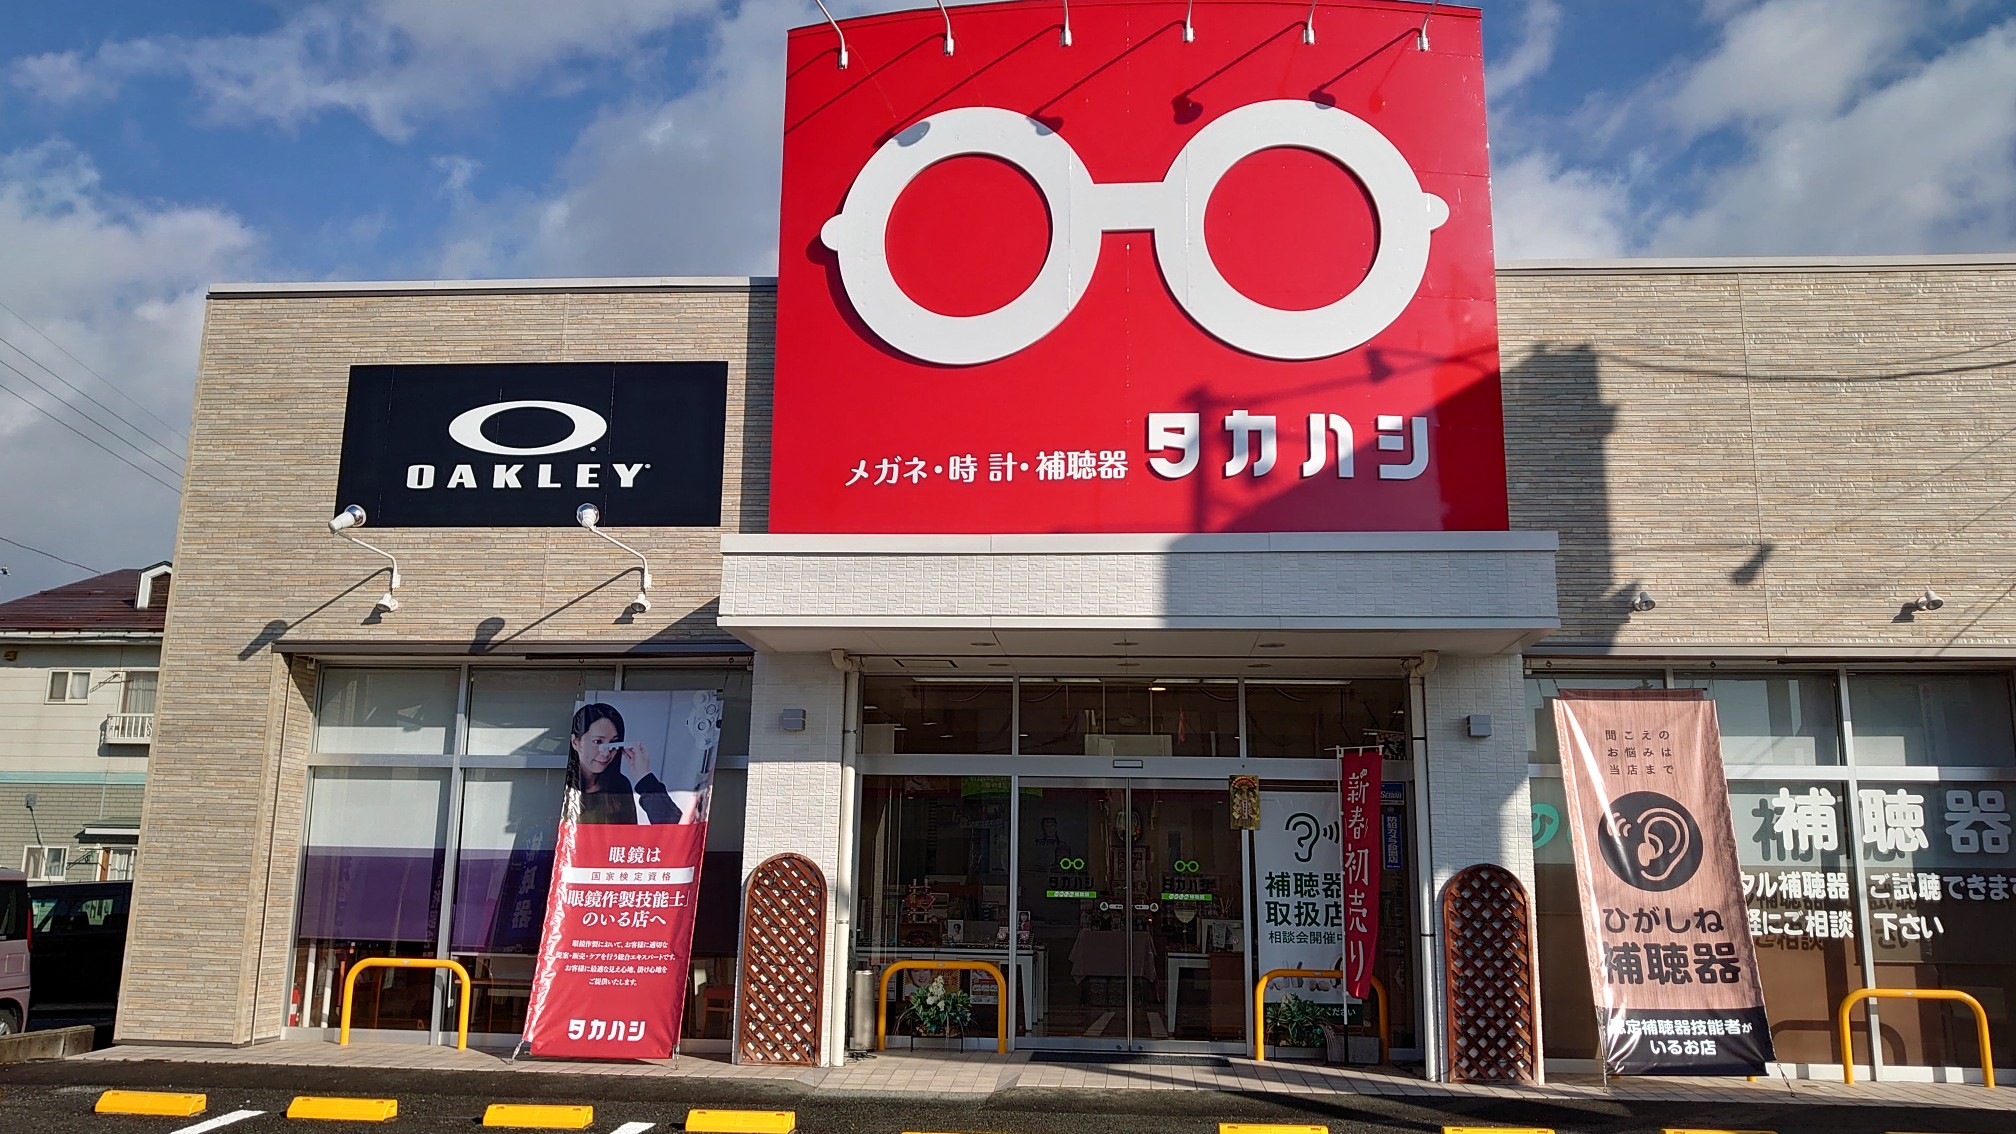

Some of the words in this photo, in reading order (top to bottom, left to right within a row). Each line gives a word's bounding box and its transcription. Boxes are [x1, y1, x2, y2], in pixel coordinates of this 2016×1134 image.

[1147, 409, 1429, 480] タカハシ
[406, 463, 645, 490] OAKLEY
[845, 450, 1129, 486] メガネ・時計・補聴器
[1605, 730, 1670, 741] 聞こえの
[1607, 747, 1673, 758] お悩みは
[1609, 764, 1675, 775] 当店まで
[1772, 787, 2012, 854] 補聴器
[608, 846, 662, 864] 眼鏡は
[591, 871, 672, 882] 国家検定資格
[1265, 871, 1342, 898] 補聴器
[582, 910, 667, 928] のいる店へ
[1265, 901, 1342, 927] 取扱店
[1602, 907, 1725, 934] ひがしね
[1874, 913, 1944, 940] 下さい
[1603, 941, 1741, 985] 補聴器
[568, 1019, 646, 1042] タカハシ
[1650, 1040, 1717, 1055] いるお店
